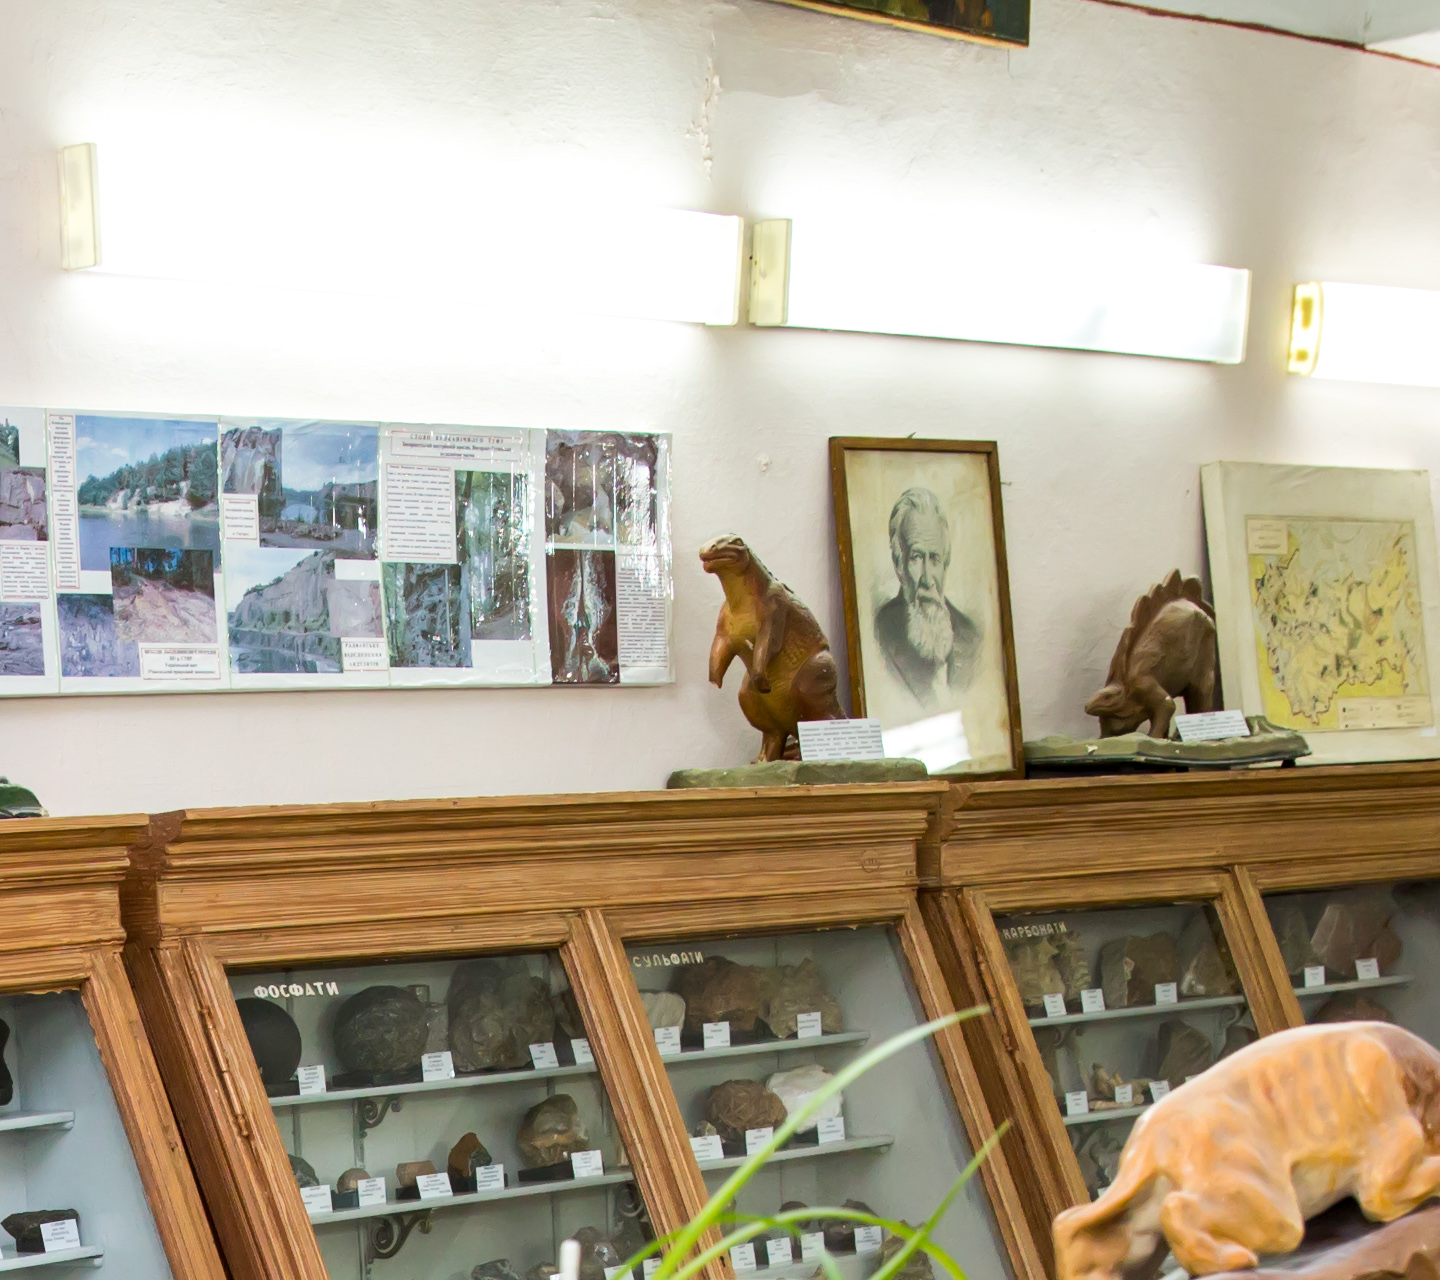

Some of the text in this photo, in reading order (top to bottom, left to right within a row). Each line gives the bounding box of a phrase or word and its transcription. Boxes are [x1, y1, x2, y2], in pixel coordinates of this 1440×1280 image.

[1001, 921, 1068, 940] КАРБОНАТИ
[632, 951, 704, 968] СУЛЬФАТИ
[254, 981, 340, 999] ФОСФАТИ
